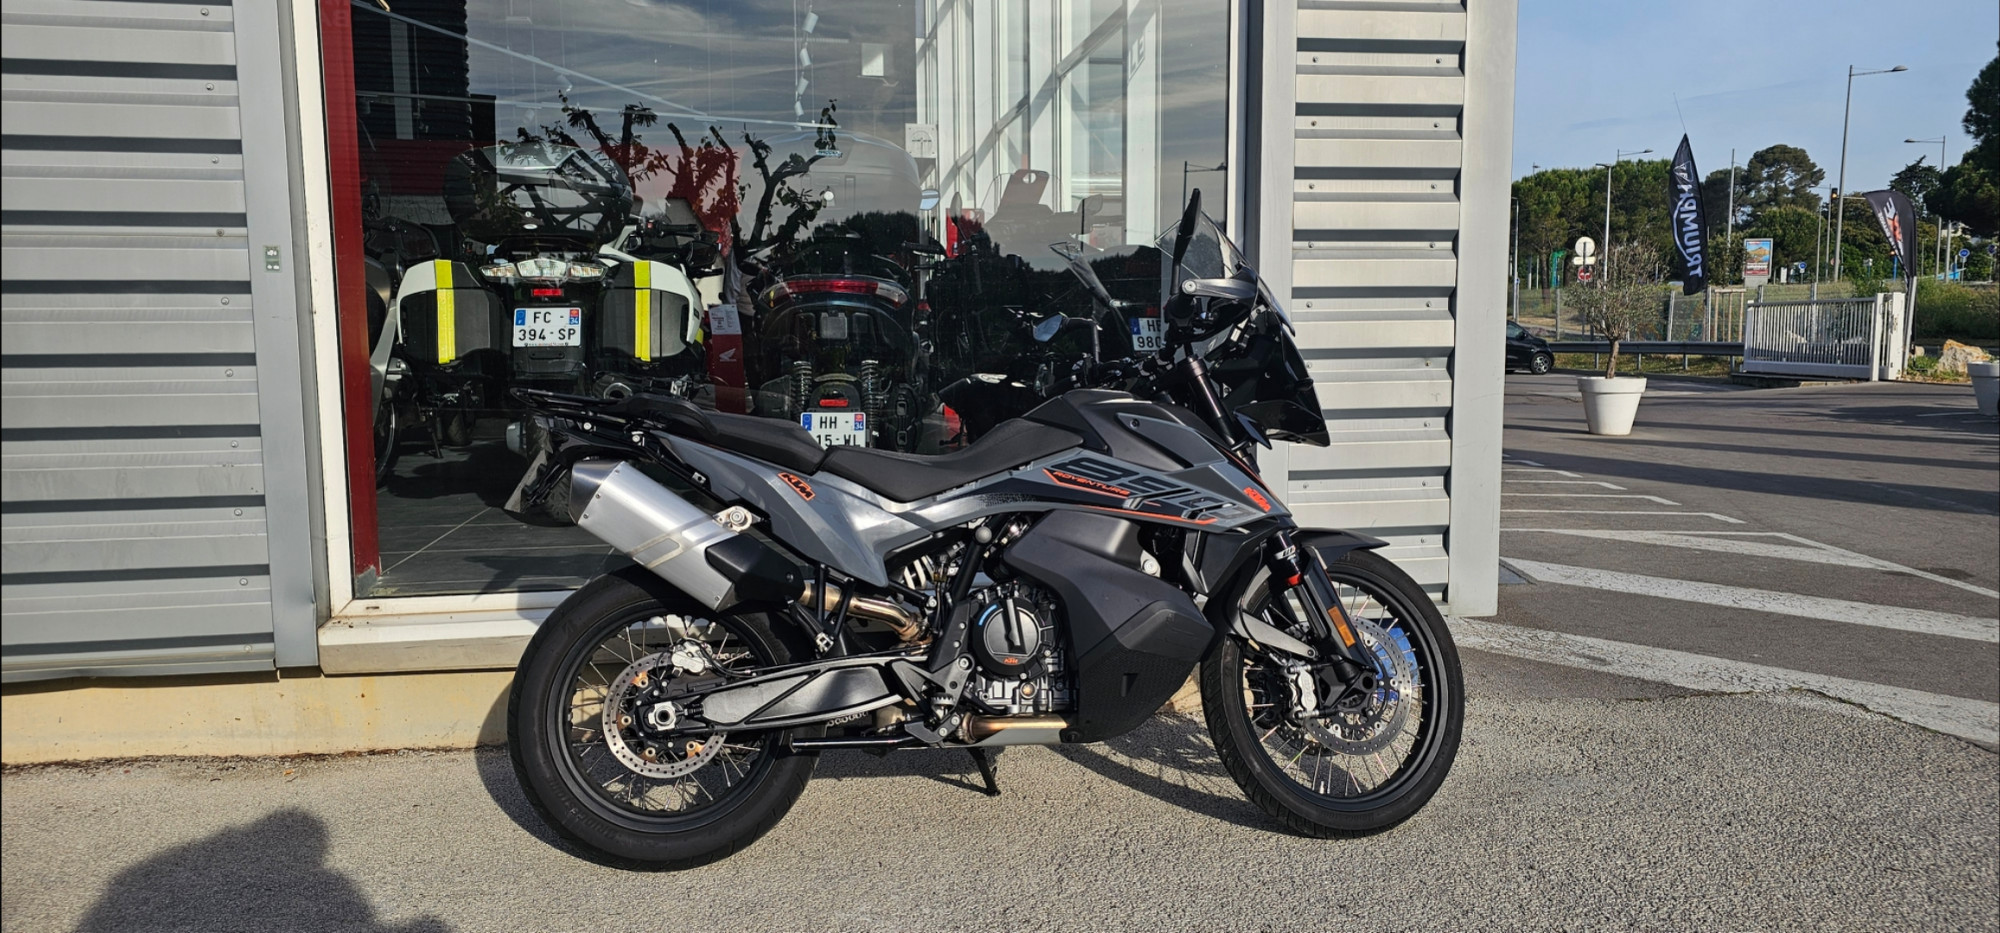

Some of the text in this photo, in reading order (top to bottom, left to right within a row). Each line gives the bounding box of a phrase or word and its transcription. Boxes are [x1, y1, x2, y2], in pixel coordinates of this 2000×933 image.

[533, 311, 551, 323] FC
[820, 416, 837, 429] HH
[778, 472, 815, 500] KTM
[1053, 471, 1131, 496] ADVENTURE
[1243, 487, 1272, 512] KTM
